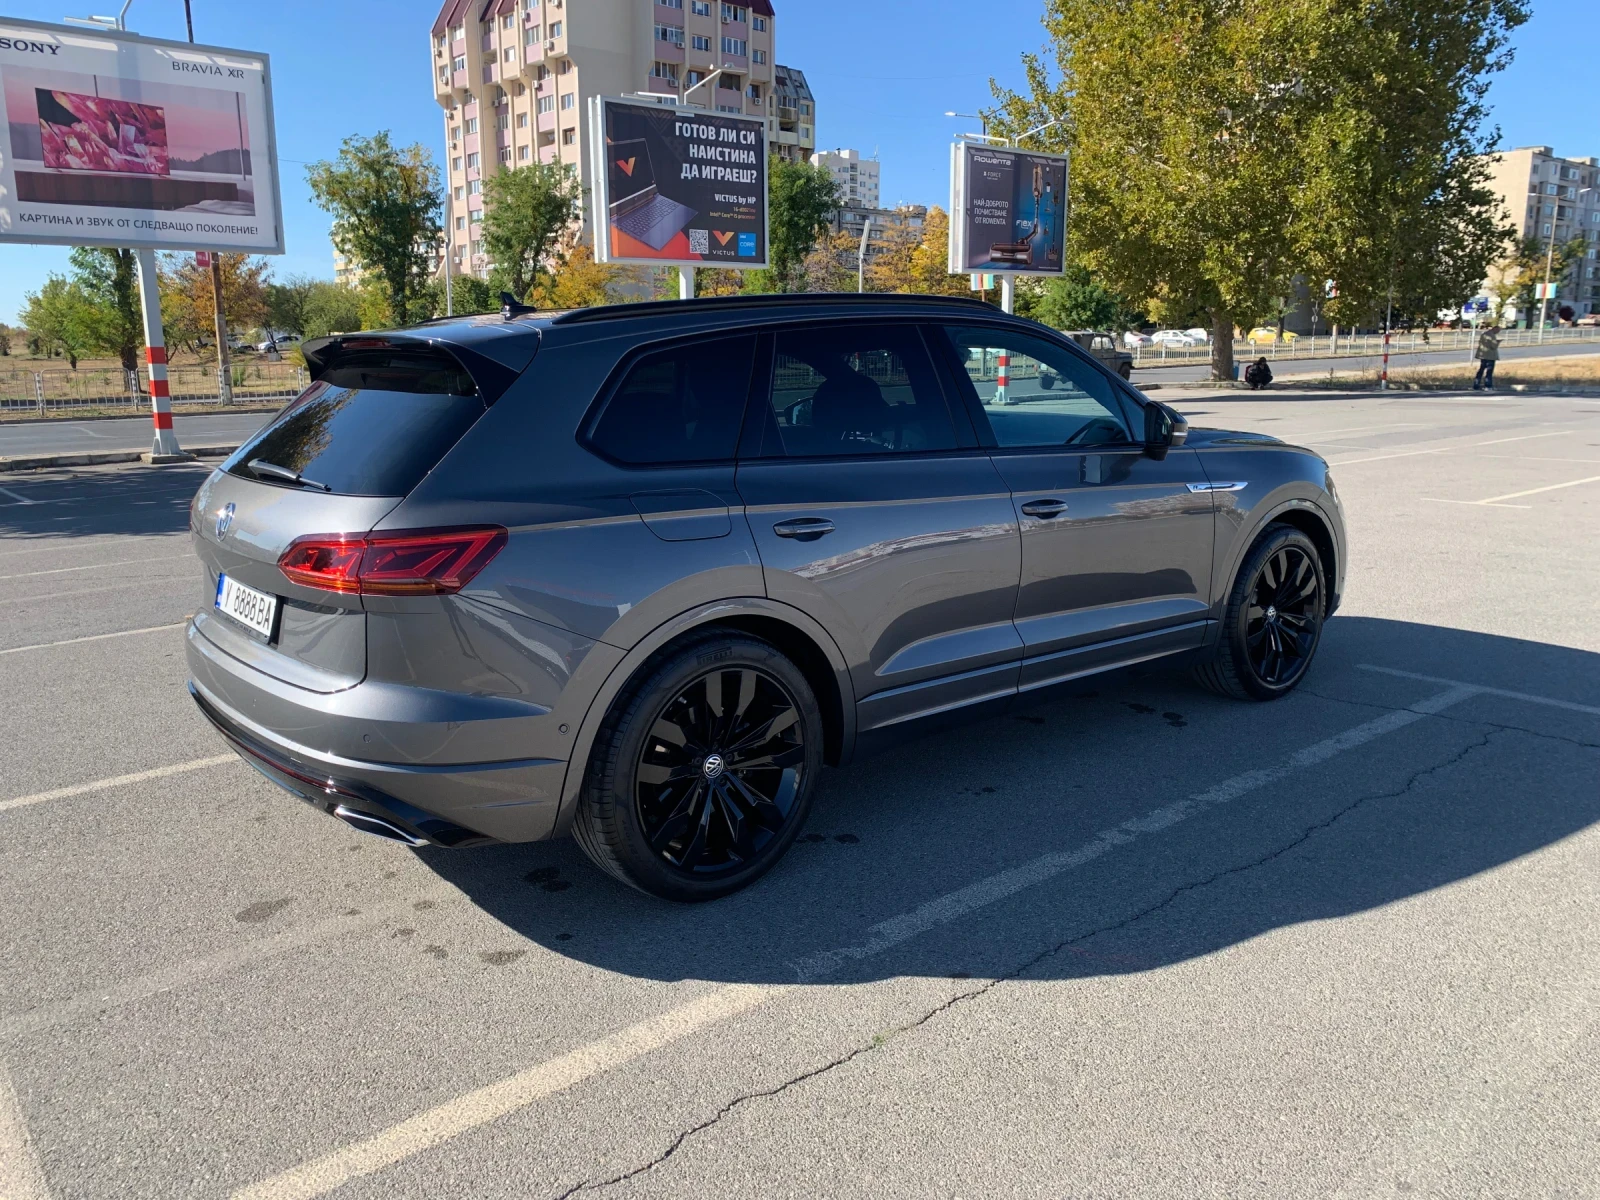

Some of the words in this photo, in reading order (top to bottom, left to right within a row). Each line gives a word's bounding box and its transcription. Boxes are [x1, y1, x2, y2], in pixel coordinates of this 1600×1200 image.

[0, 38, 61, 56] SONY
[172, 61, 222, 77] BRAVIA
[675, 122, 716, 140] ГОТОВ
[718, 128, 737, 143] ЛИ
[739, 130, 756, 145] СИ
[689, 144, 756, 164] НАИСТИНА
[680, 163, 699, 180] ДА
[702, 166, 757, 184] ИГРАЕШ?
[714, 193, 738, 203] VICTUS
[738, 195, 747, 205] by
[747, 196, 756, 204] HP
[973, 198, 1009, 208] НАЙ-ДОБРОТО
[974, 208, 1007, 217] ПОЧИСТВАНЕ
[982, 217, 1006, 225] ROWENTA
[19, 212, 73, 226] КАРТИНА
[76, 216, 84, 226] И
[87, 216, 115, 228] ЗВУК
[116, 218, 131, 228] ОТ
[133, 219, 194, 233] СЛЕДВАЩО
[196, 223, 258, 235] ПОКОЛЕНИЕ!
[233, 586, 257, 622] 8888
